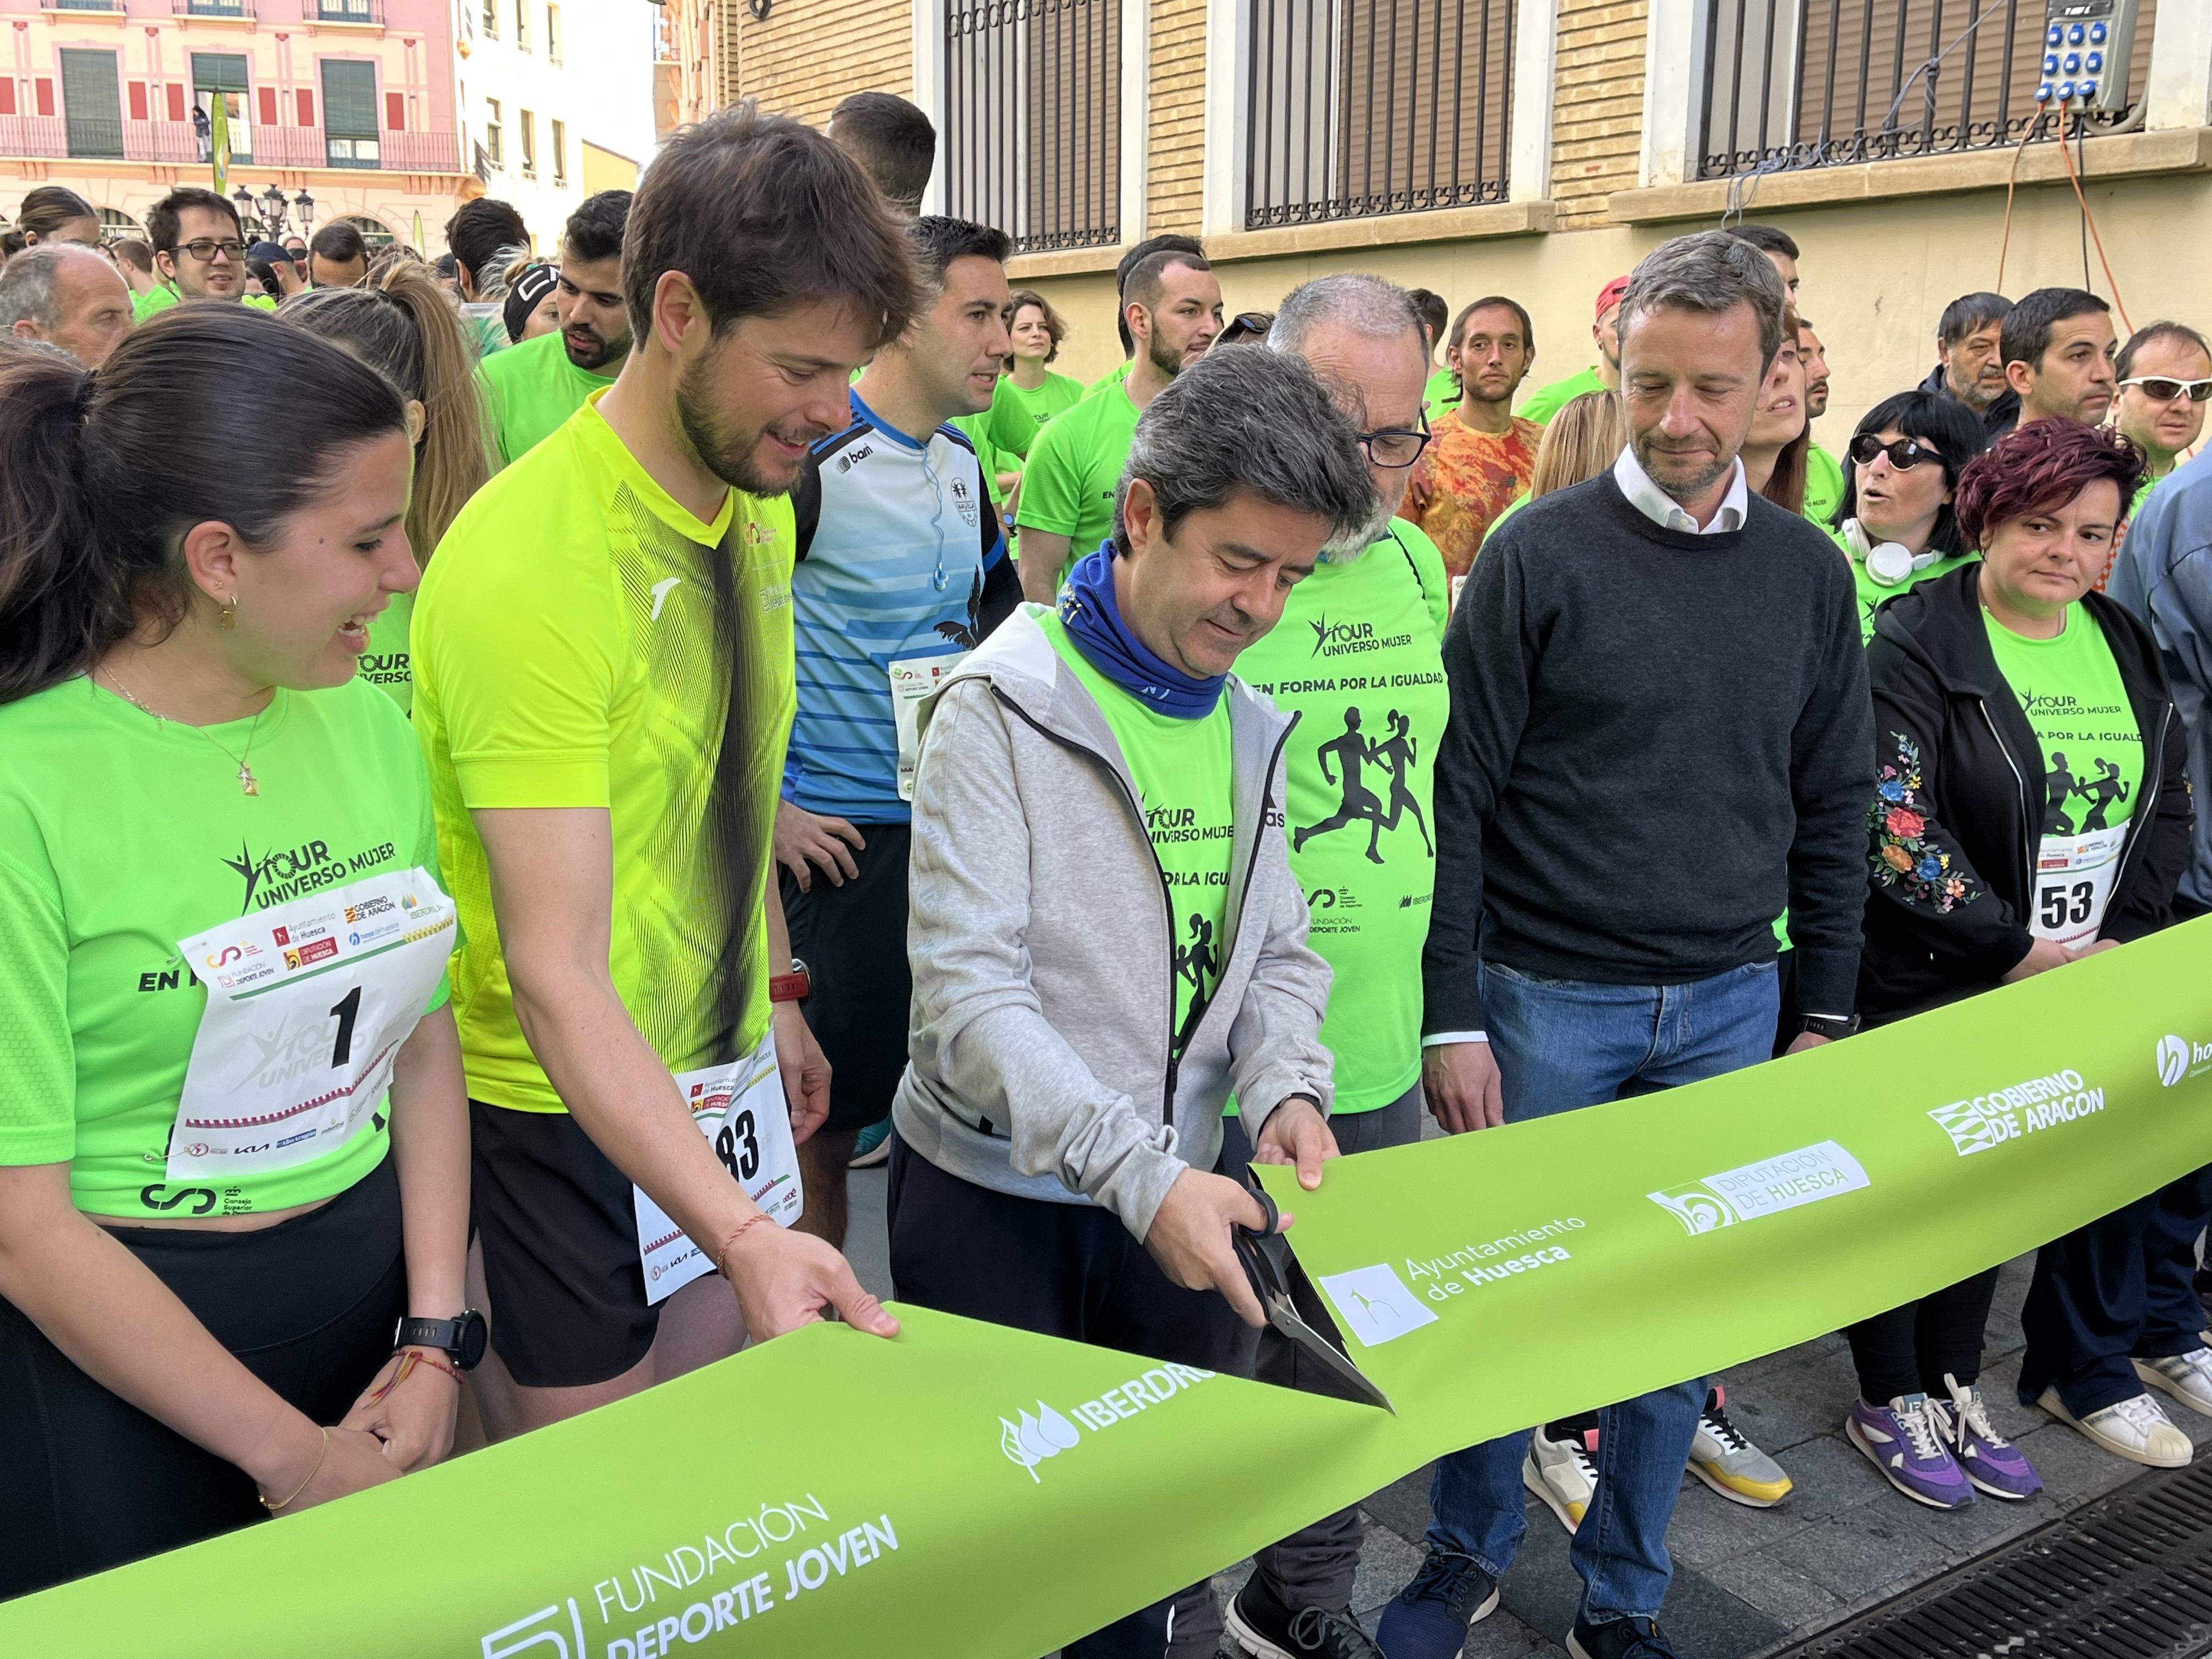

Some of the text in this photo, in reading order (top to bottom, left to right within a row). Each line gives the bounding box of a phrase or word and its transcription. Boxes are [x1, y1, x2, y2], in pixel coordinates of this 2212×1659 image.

[1328, 623, 1373, 642] TOUR
[1323, 634, 1412, 657] UNIVERSO MUJER
[358, 653, 409, 673] OUR
[357, 670, 412, 684] VERSO
[1279, 679, 1336, 695] FORMA
[1340, 677, 1367, 690] POR
[1371, 676, 1387, 689] LA
[1391, 672, 1443, 687] IGUALDAD
[2030, 706, 2122, 716] UNIVERSO MUJER
[2035, 695, 2077, 708] TOUR
[2048, 731, 2074, 740] POR
[2078, 732, 2096, 741] LA
[2100, 732, 2142, 741] IGUALD
[1146, 808, 1195, 829] TOUR
[1202, 825, 1233, 840] MUJE
[256, 840, 332, 884] TOUR
[255, 842, 396, 910] UNIVERSO MUJER
[1163, 872, 1230, 886] OR LA IGU
[2041, 881, 2094, 929] 53
[289, 912, 336, 933] Ayuntamiento
[356, 912, 367, 922] DE
[291, 927, 325, 943] de Huesca
[138, 969, 179, 992] EN
[329, 985, 362, 1069] 1
[1973, 1069, 2084, 1116] GOBIERNO
[1988, 1087, 2105, 1143] DE ARAGON
[706, 1110, 760, 1183] 83
[1717, 1150, 1832, 1192] DIPUTACIÓN
[1735, 1167, 1849, 1210] DE HUESCA
[1405, 1217, 1586, 1281] Ayuntamiento
[1427, 1246, 1572, 1301] de Huesca
[594, 1492, 830, 1624] FUNDACIÓN
[607, 1514, 899, 1659] DEPORTE JOVEN
